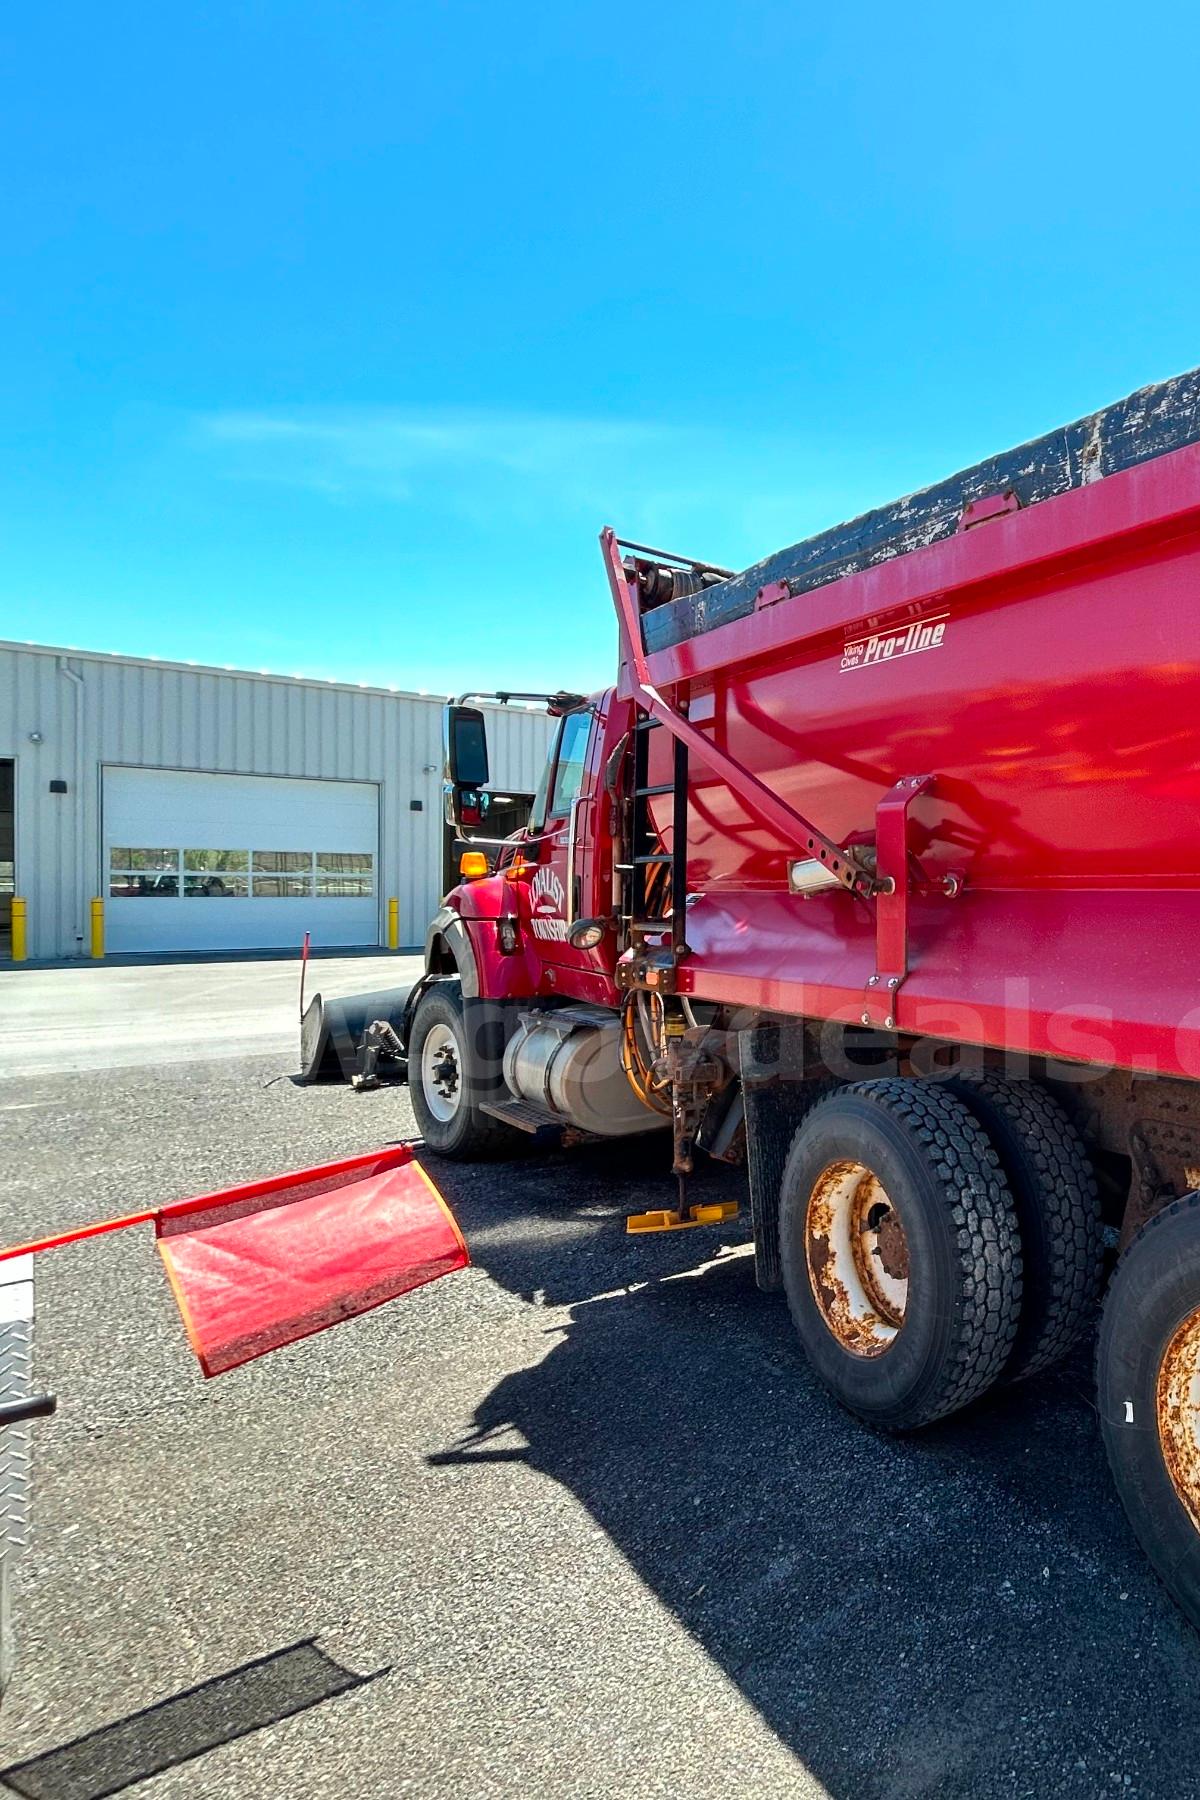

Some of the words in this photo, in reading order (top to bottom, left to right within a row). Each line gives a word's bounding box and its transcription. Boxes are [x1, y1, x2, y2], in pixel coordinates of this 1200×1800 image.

[843, 643, 864, 658] Viking
[863, 622, 946, 663] Pro-line
[528, 867, 565, 913] LOYALIST
